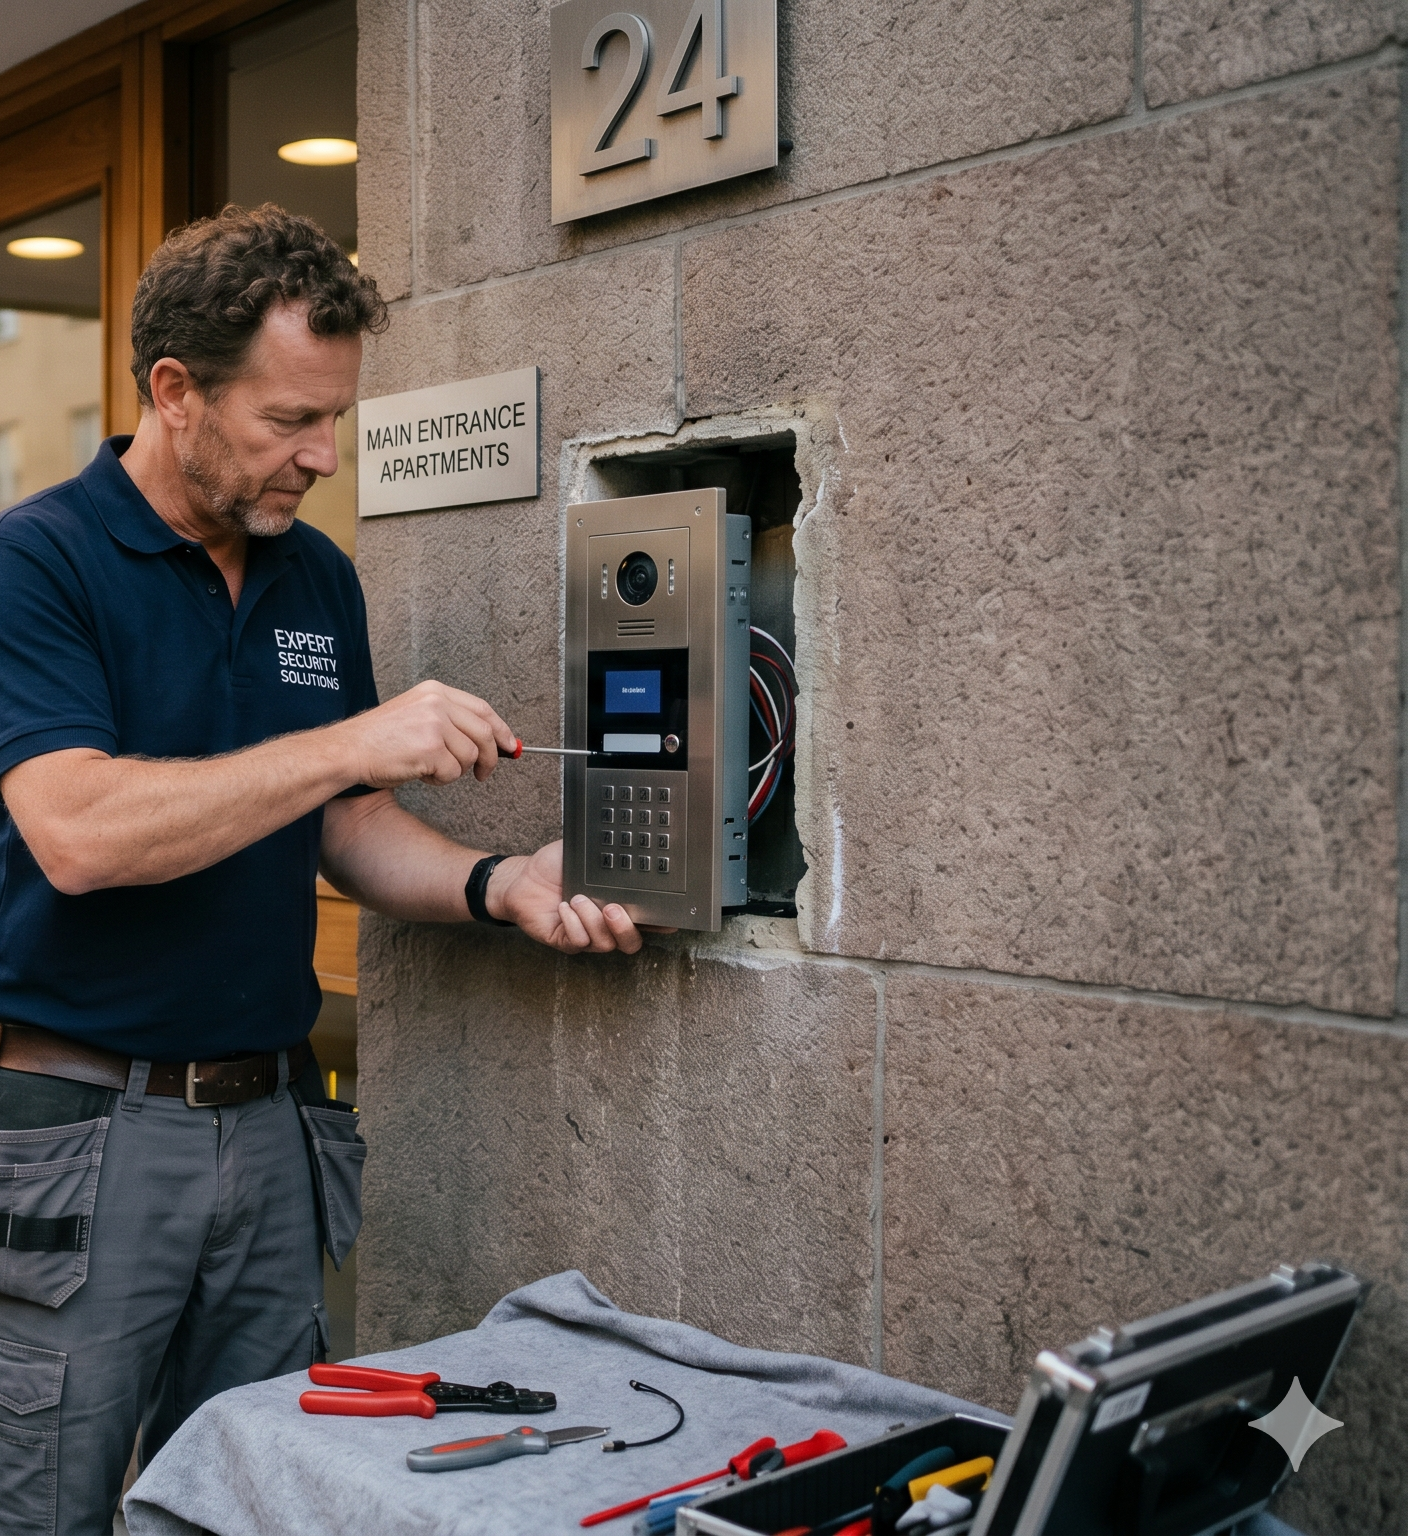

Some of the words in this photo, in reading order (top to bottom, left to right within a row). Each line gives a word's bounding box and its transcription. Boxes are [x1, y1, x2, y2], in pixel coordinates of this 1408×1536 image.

[579, 0, 739, 176] 24
[366, 421, 411, 451] MAIN
[417, 401, 526, 443] ENTRANCE
[380, 441, 510, 483] APARTMENTS
[274, 628, 334, 654] EXPERT
[278, 651, 336, 672] SECURITY
[280, 669, 339, 690] SOLUTIONS
